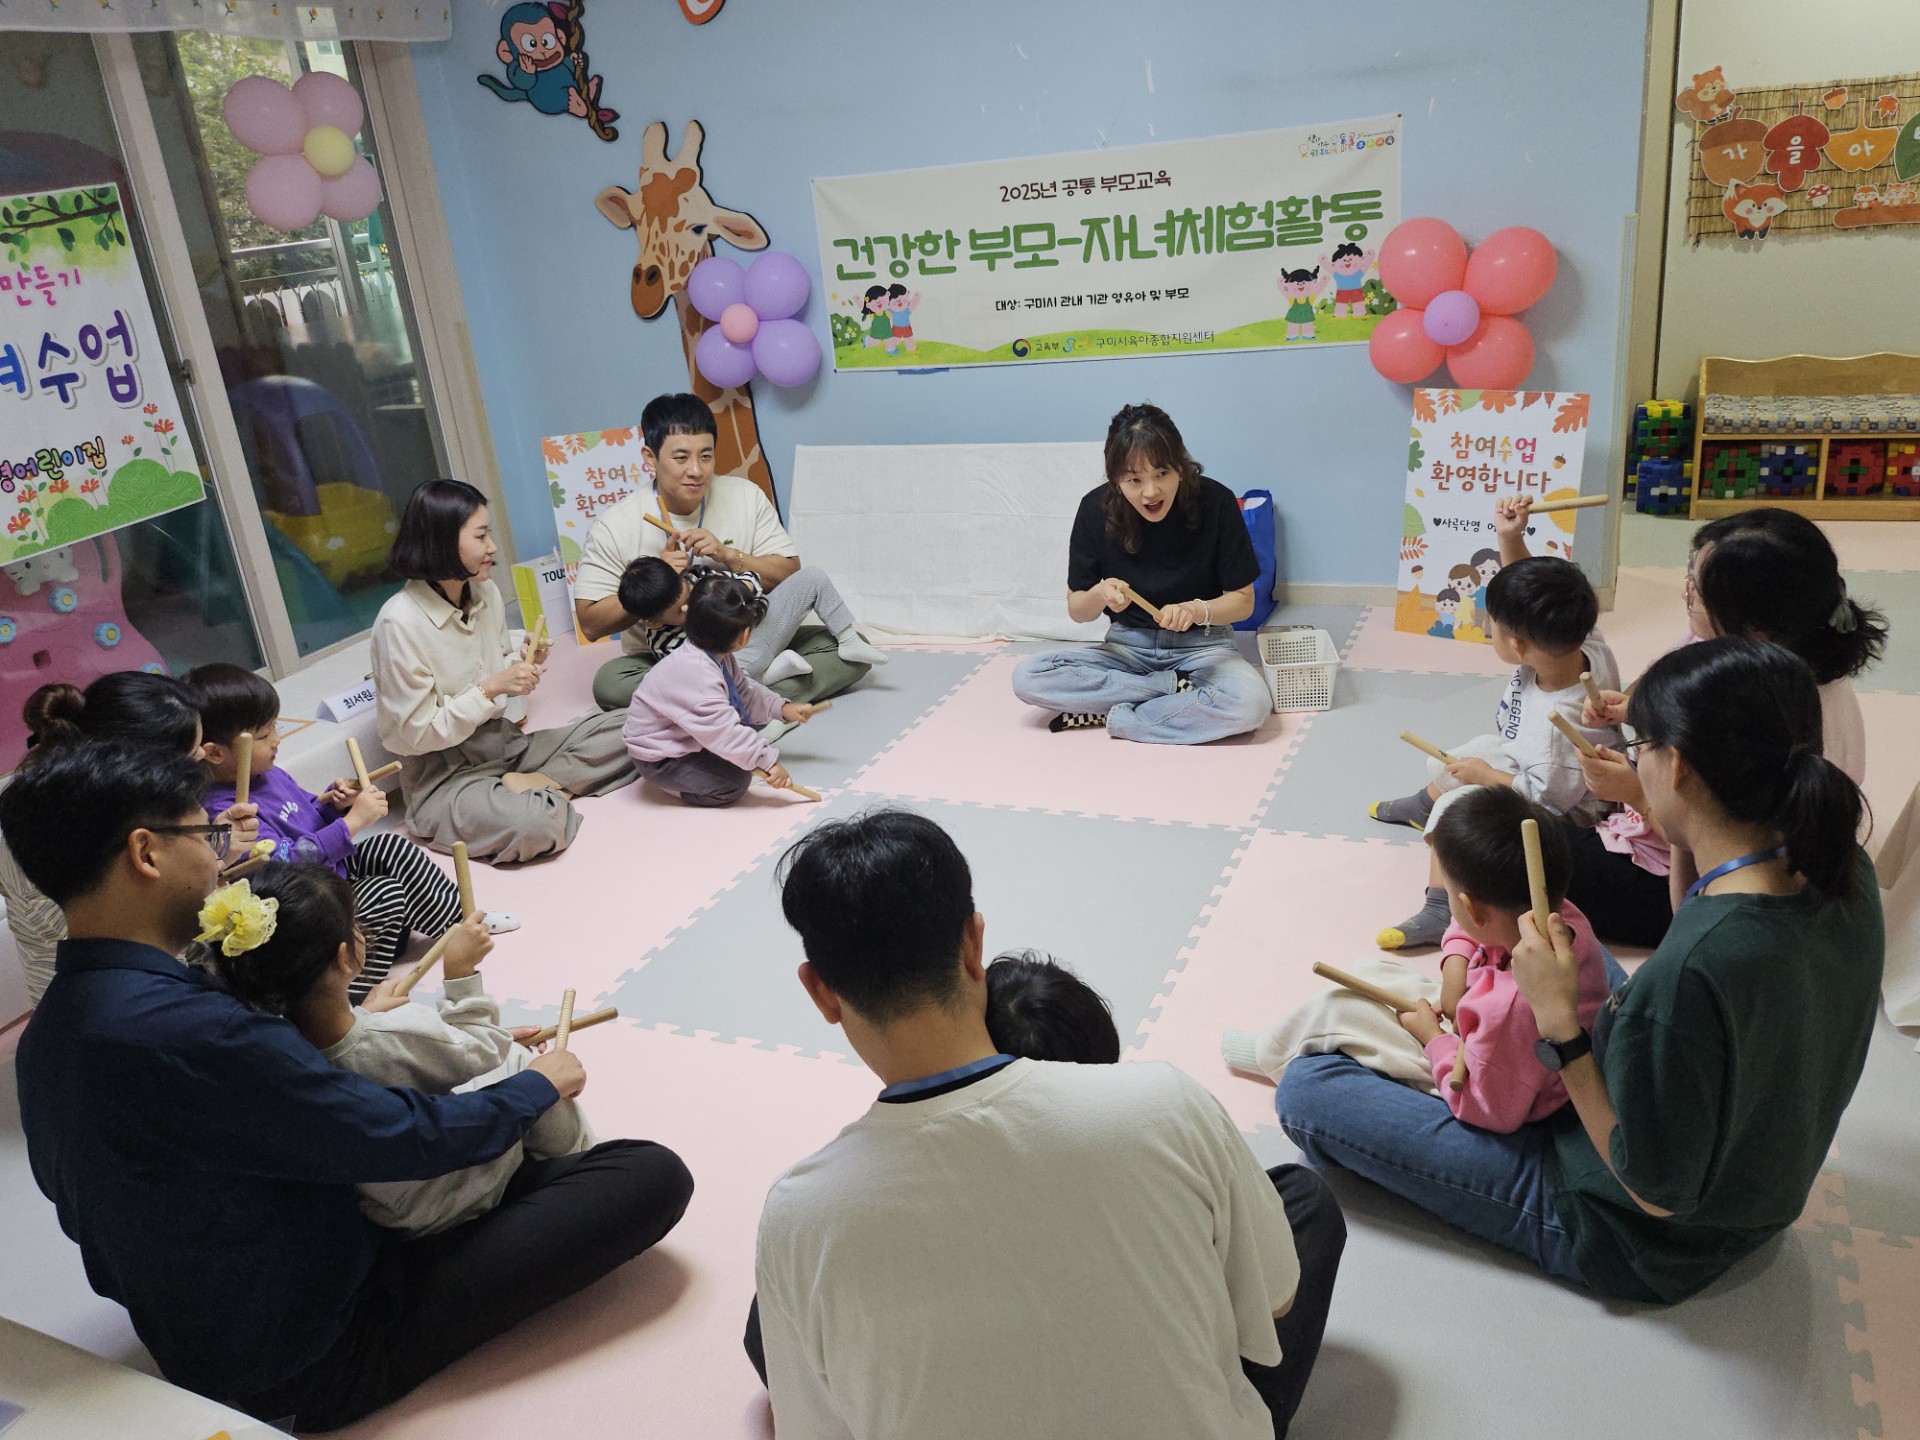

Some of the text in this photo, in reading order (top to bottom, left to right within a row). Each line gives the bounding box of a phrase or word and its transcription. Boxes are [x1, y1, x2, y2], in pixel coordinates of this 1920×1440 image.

[1000, 170, 1171, 203] 2025년 공통 부모교육
[833, 229, 961, 281] 건강한
[0, 265, 82, 306] 만들기
[995, 287, 1190, 311] 대상: 구미시 관내 기관 영유아 및 부모
[1096, 330, 1215, 349] 구미시육아종합지원센터
[1449, 431, 1538, 463] 참여수업
[1430, 460, 1552, 494] 환영합니다
[343, 688, 374, 709] 최서원
[1504, 690, 1522, 741] LEGEND
